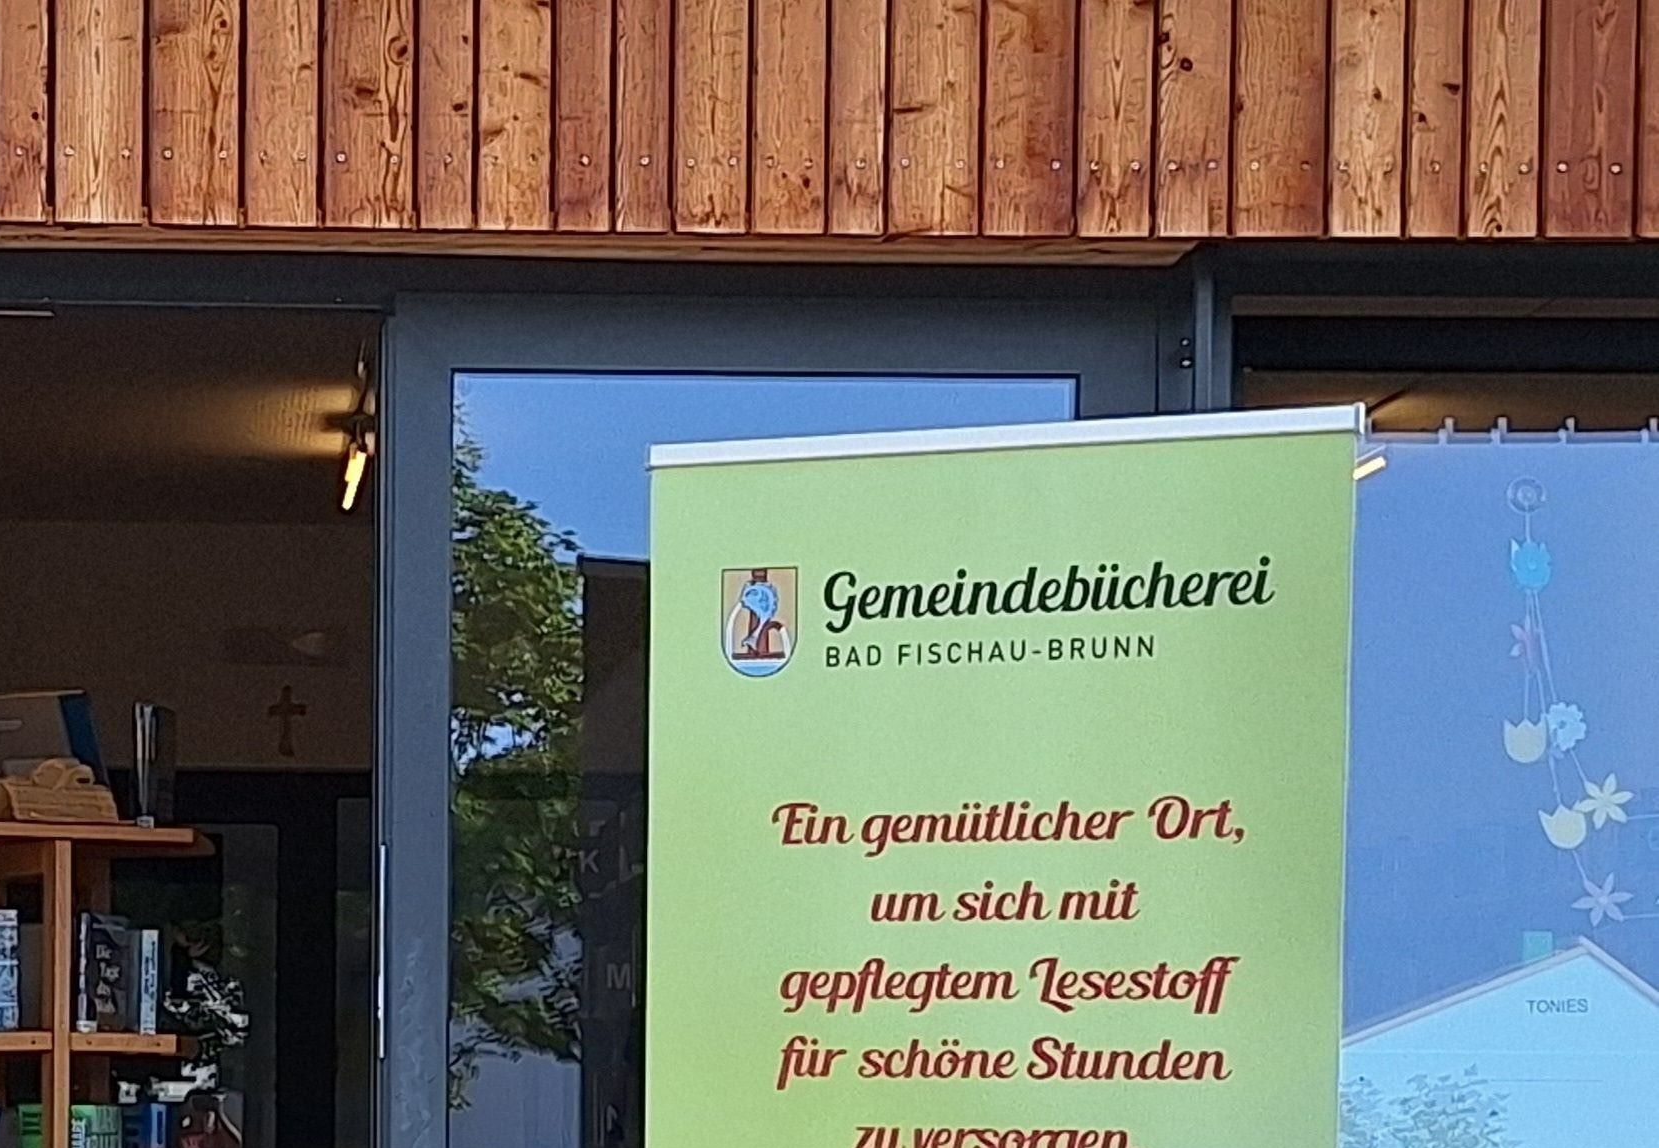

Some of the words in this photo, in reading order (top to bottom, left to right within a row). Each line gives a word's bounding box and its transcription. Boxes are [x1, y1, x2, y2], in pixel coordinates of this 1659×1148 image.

[824, 556, 1275, 633] Gemeindebücherei
[826, 645, 881, 667] BAD
[898, 635, 1154, 665] FISCHAU-BRUNN
[772, 803, 854, 845] Ein
[861, 801, 1135, 857] gemütlicher
[1148, 796, 1244, 844] Ort,
[871, 893, 946, 922] um
[953, 881, 1051, 921] sich
[1059, 879, 1140, 920] mit
[780, 958, 1019, 1013] gepflegtem
[1029, 957, 1240, 1014] Lesestoff
[1526, 998, 1588, 1015] TONIES
[777, 1036, 847, 1090] für
[858, 1039, 1018, 1079] schöne
[1027, 1036, 1232, 1080] Stunden
